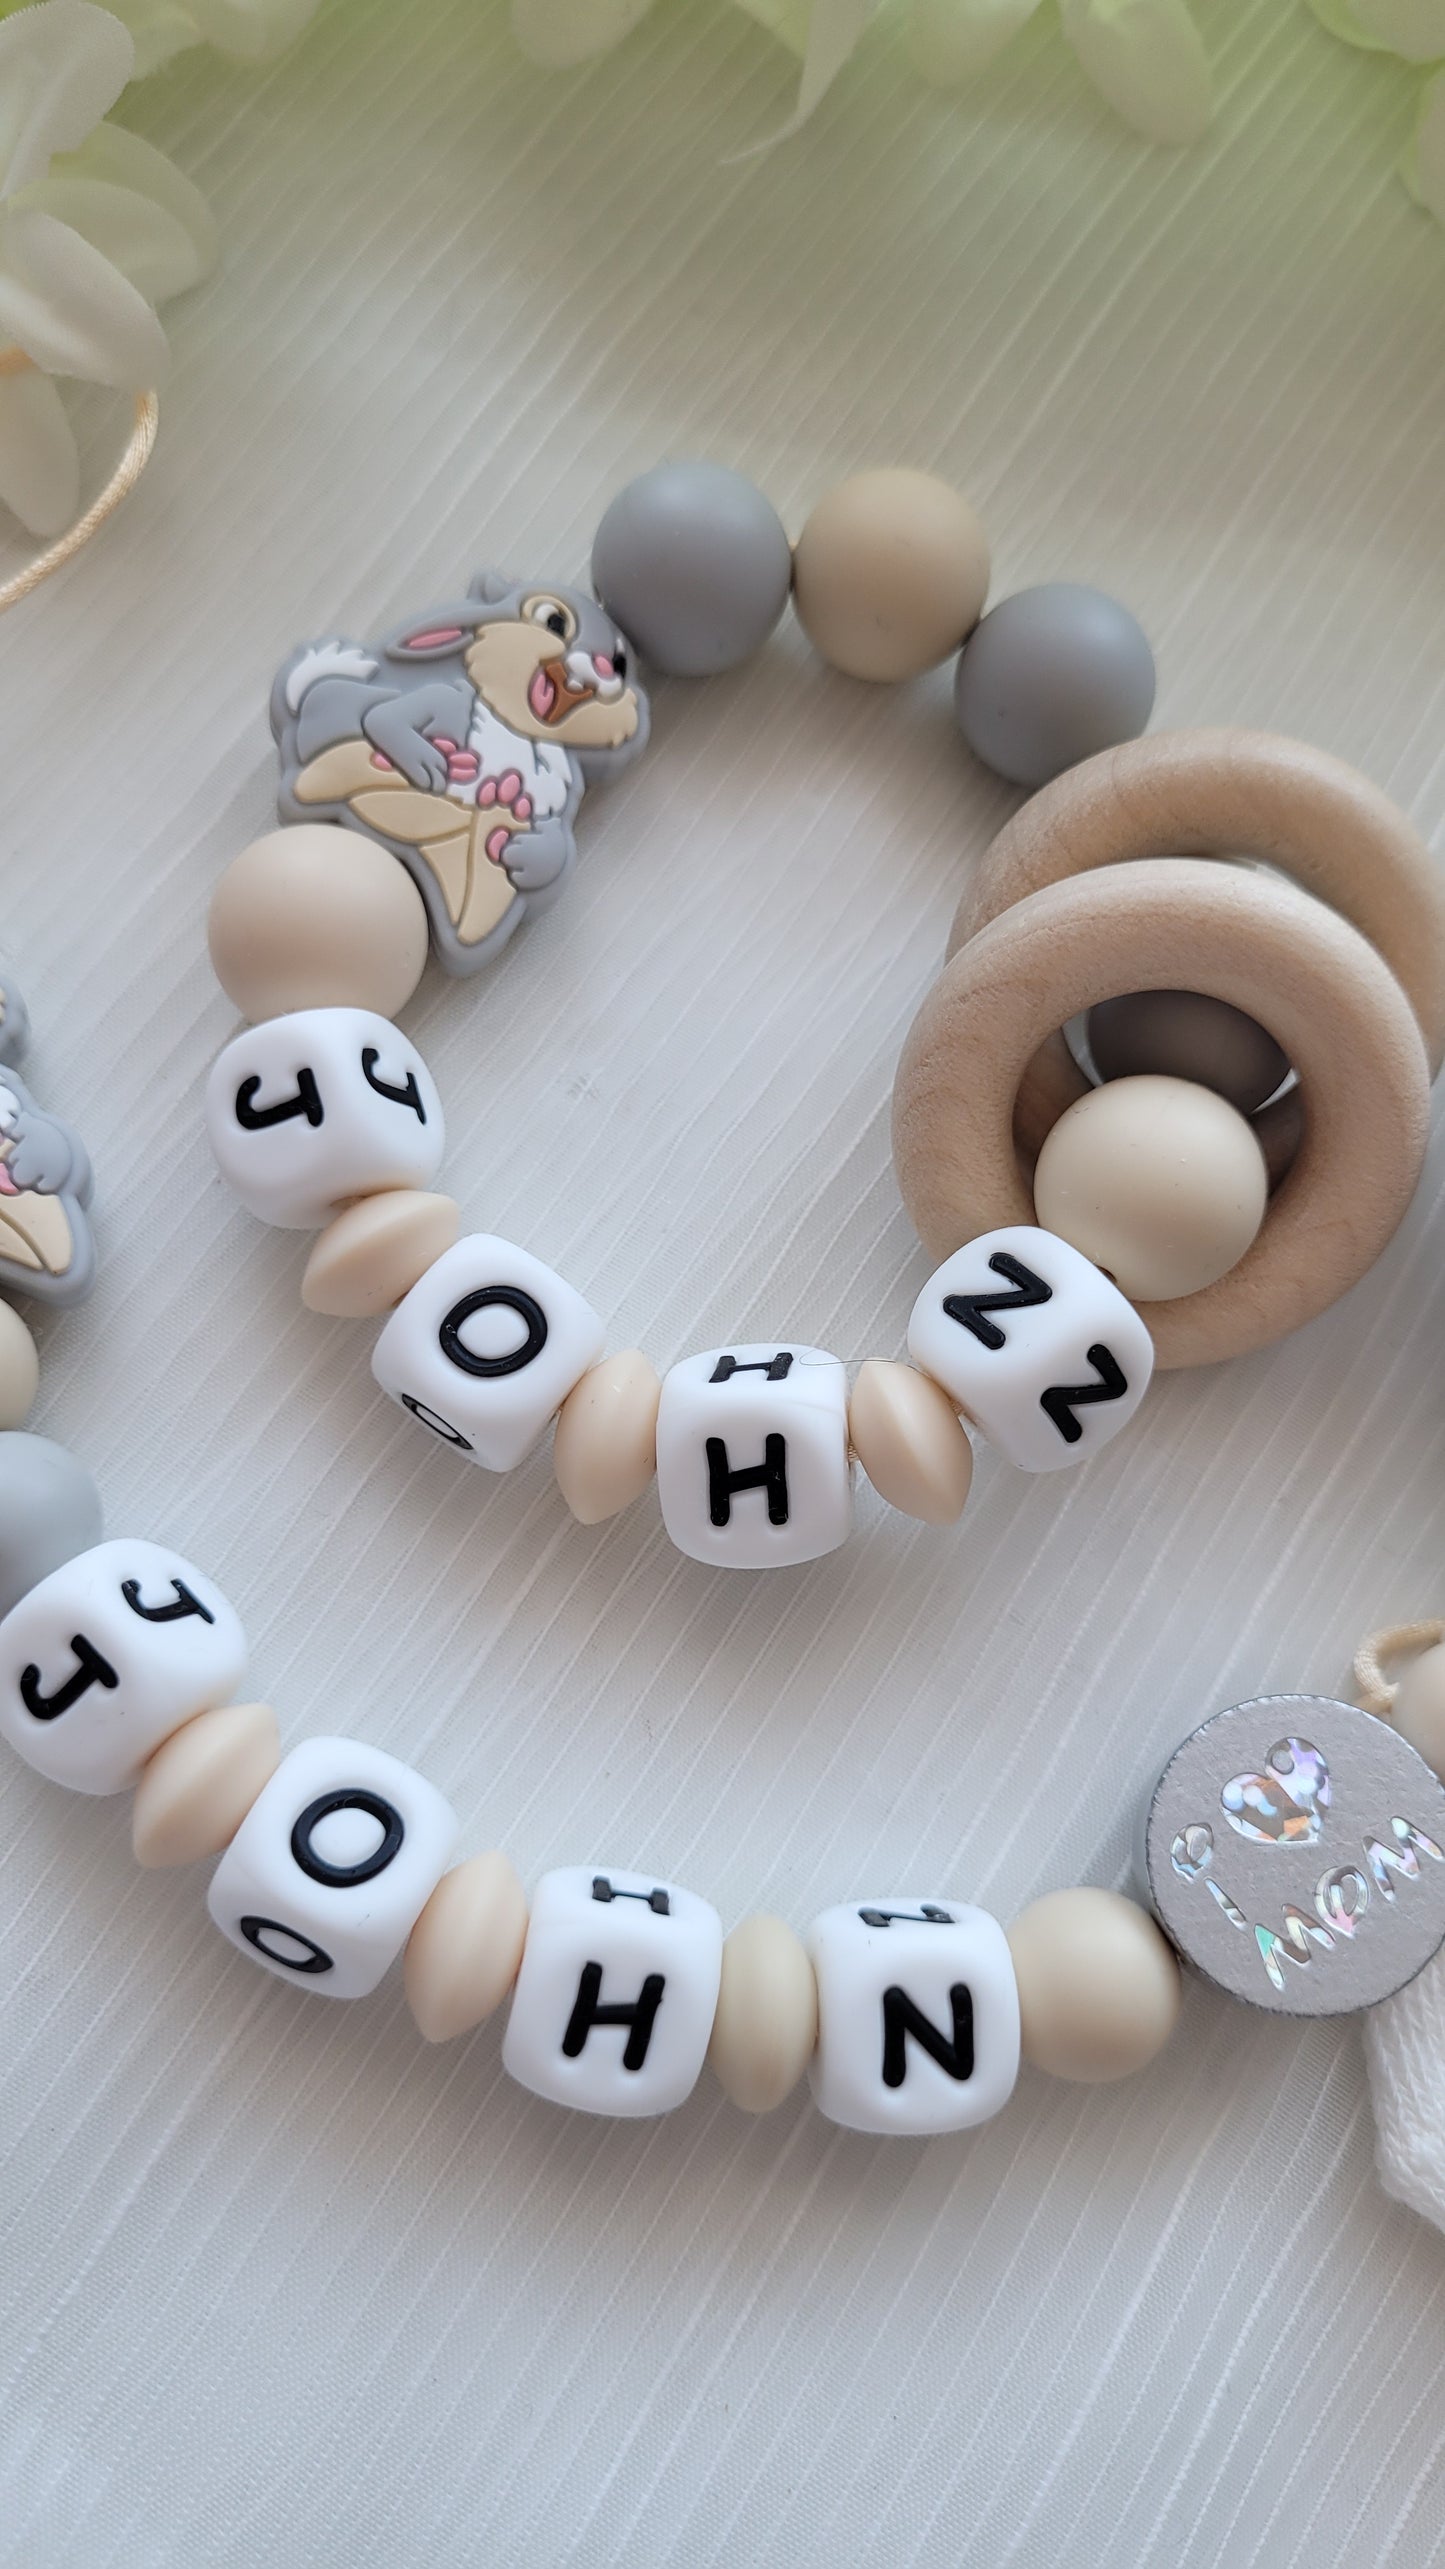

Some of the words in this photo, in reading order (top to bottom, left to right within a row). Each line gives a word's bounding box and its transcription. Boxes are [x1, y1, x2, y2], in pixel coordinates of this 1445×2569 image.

[236, 1067, 325, 1131] J
[361, 1047, 427, 1126] J
[438, 1285, 549, 1379] O
[942, 1251, 1054, 1351] N
[708, 1351, 794, 1384] H
[1039, 1343, 1129, 1444] N
[705, 1432, 791, 1528] H
[121, 1578, 216, 1625] J
[19, 1633, 120, 1721] J
[290, 1788, 406, 1889] O
[592, 1875, 671, 1917] H
[239, 1915, 335, 1975] O
[561, 1960, 667, 2072] H
[881, 1981, 976, 2089] N
